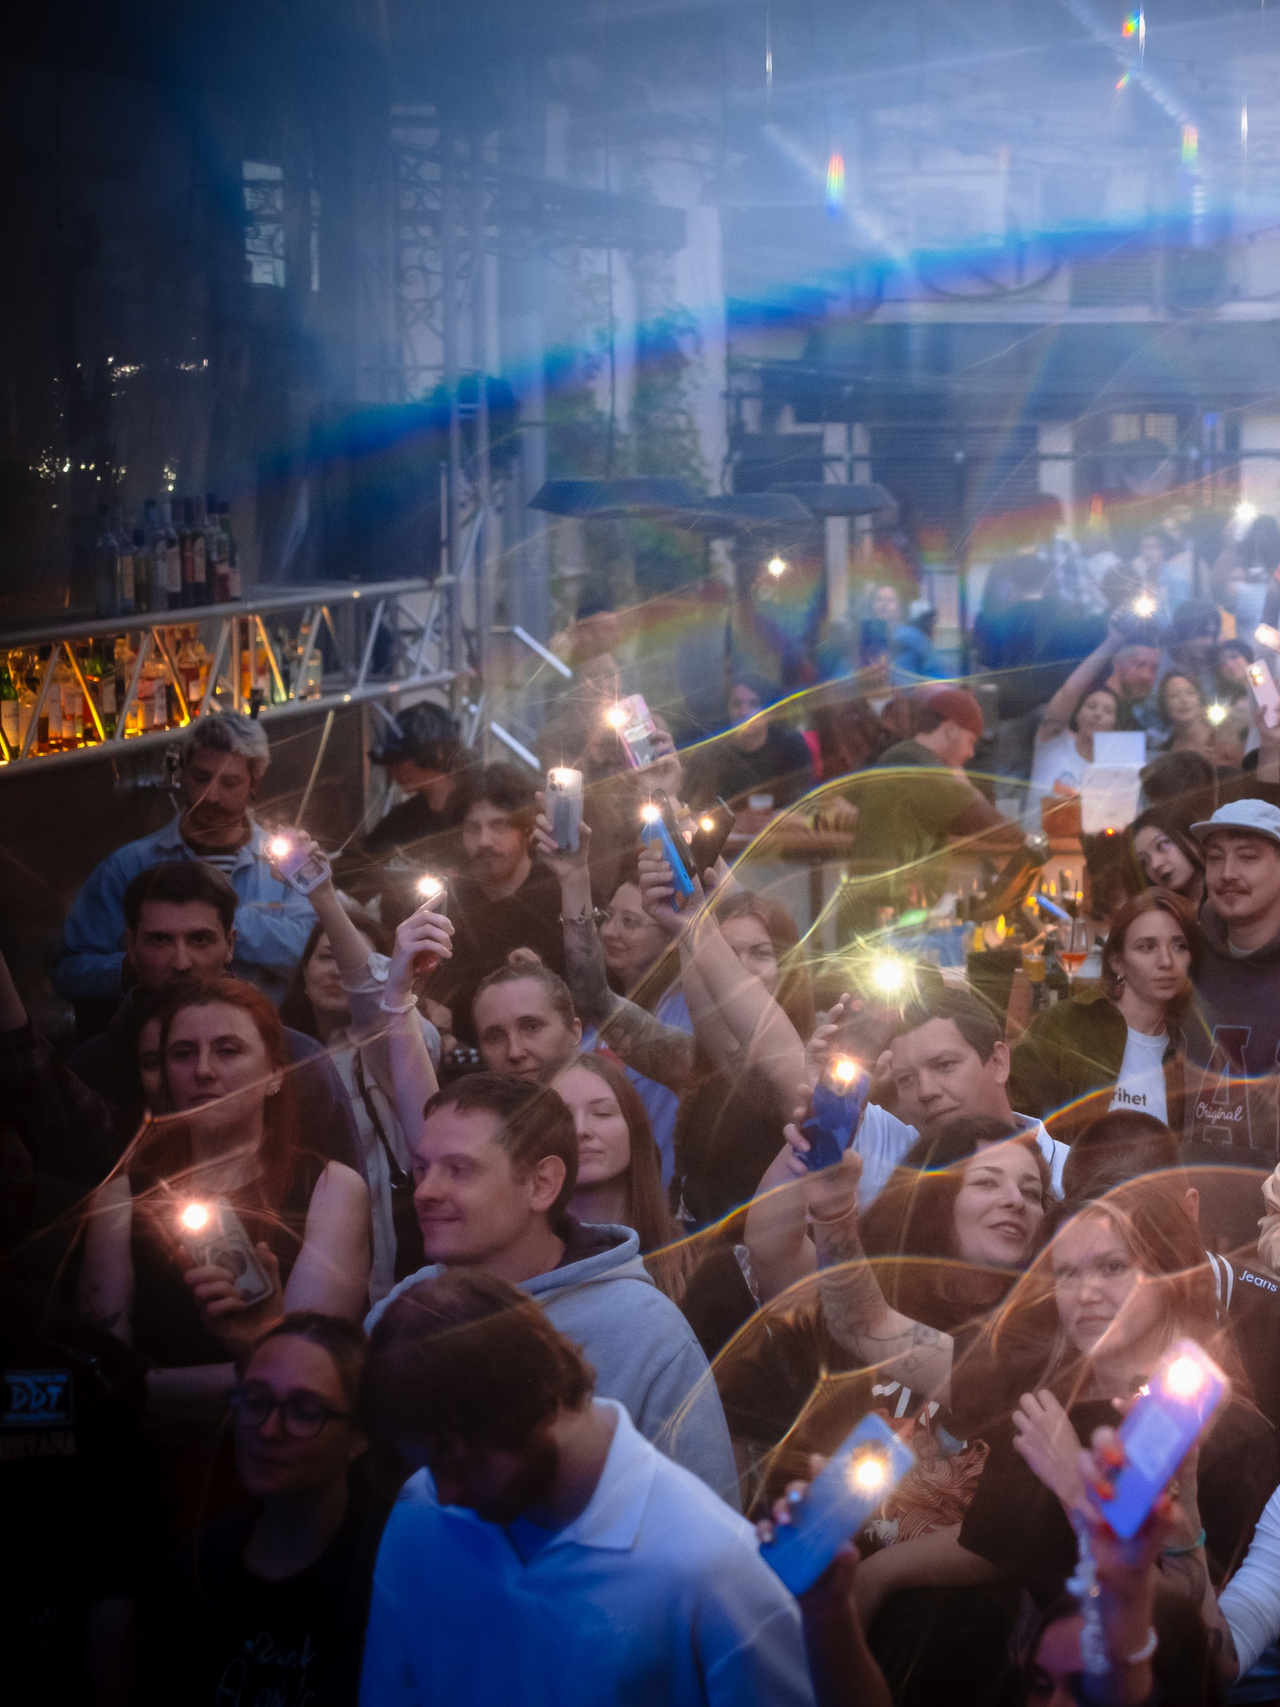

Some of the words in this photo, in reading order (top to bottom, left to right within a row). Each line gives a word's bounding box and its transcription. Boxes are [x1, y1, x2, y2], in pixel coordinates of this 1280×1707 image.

[1195, 1101, 1243, 1124] Original
[1239, 1270, 1279, 1293] Jeans
[9, 1382, 65, 1412] DDT
